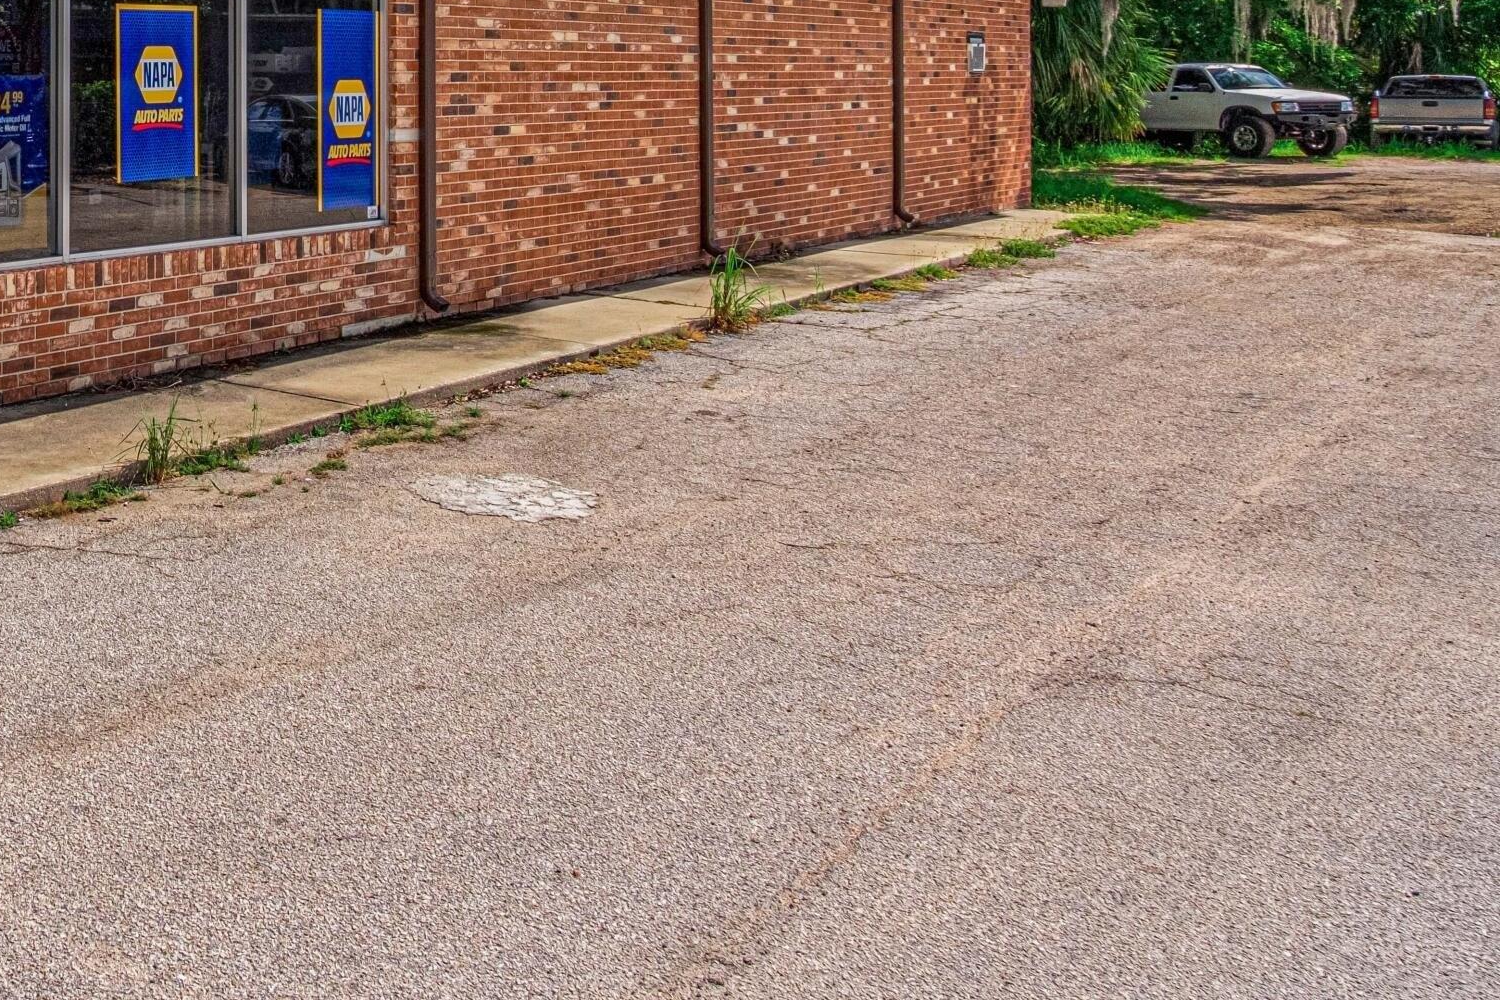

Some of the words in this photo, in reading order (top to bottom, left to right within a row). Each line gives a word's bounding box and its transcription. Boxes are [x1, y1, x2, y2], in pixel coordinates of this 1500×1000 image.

[143, 61, 176, 89] NAPA
[133, 109, 158, 124] AUTO
[157, 107, 184, 122] PARTS
[336, 95, 364, 123] NAPA
[327, 144, 349, 160] AUTO
[348, 142, 372, 159] PARTS
